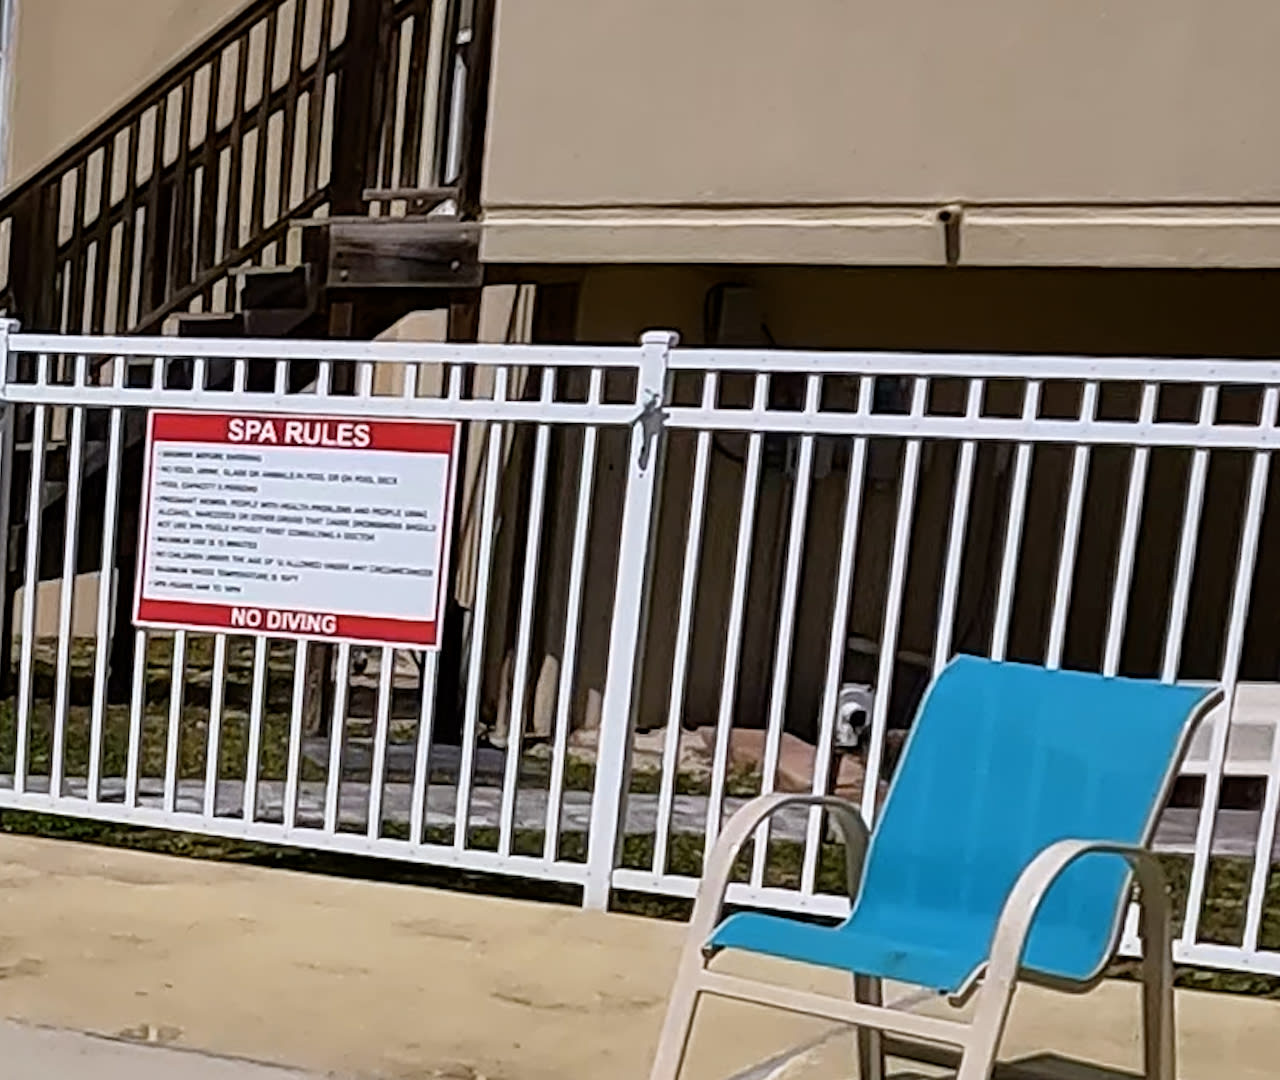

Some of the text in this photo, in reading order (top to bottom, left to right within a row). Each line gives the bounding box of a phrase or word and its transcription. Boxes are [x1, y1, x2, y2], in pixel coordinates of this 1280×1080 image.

[227, 418, 371, 447] SPA RULES
[231, 608, 337, 634] NO DIVING
